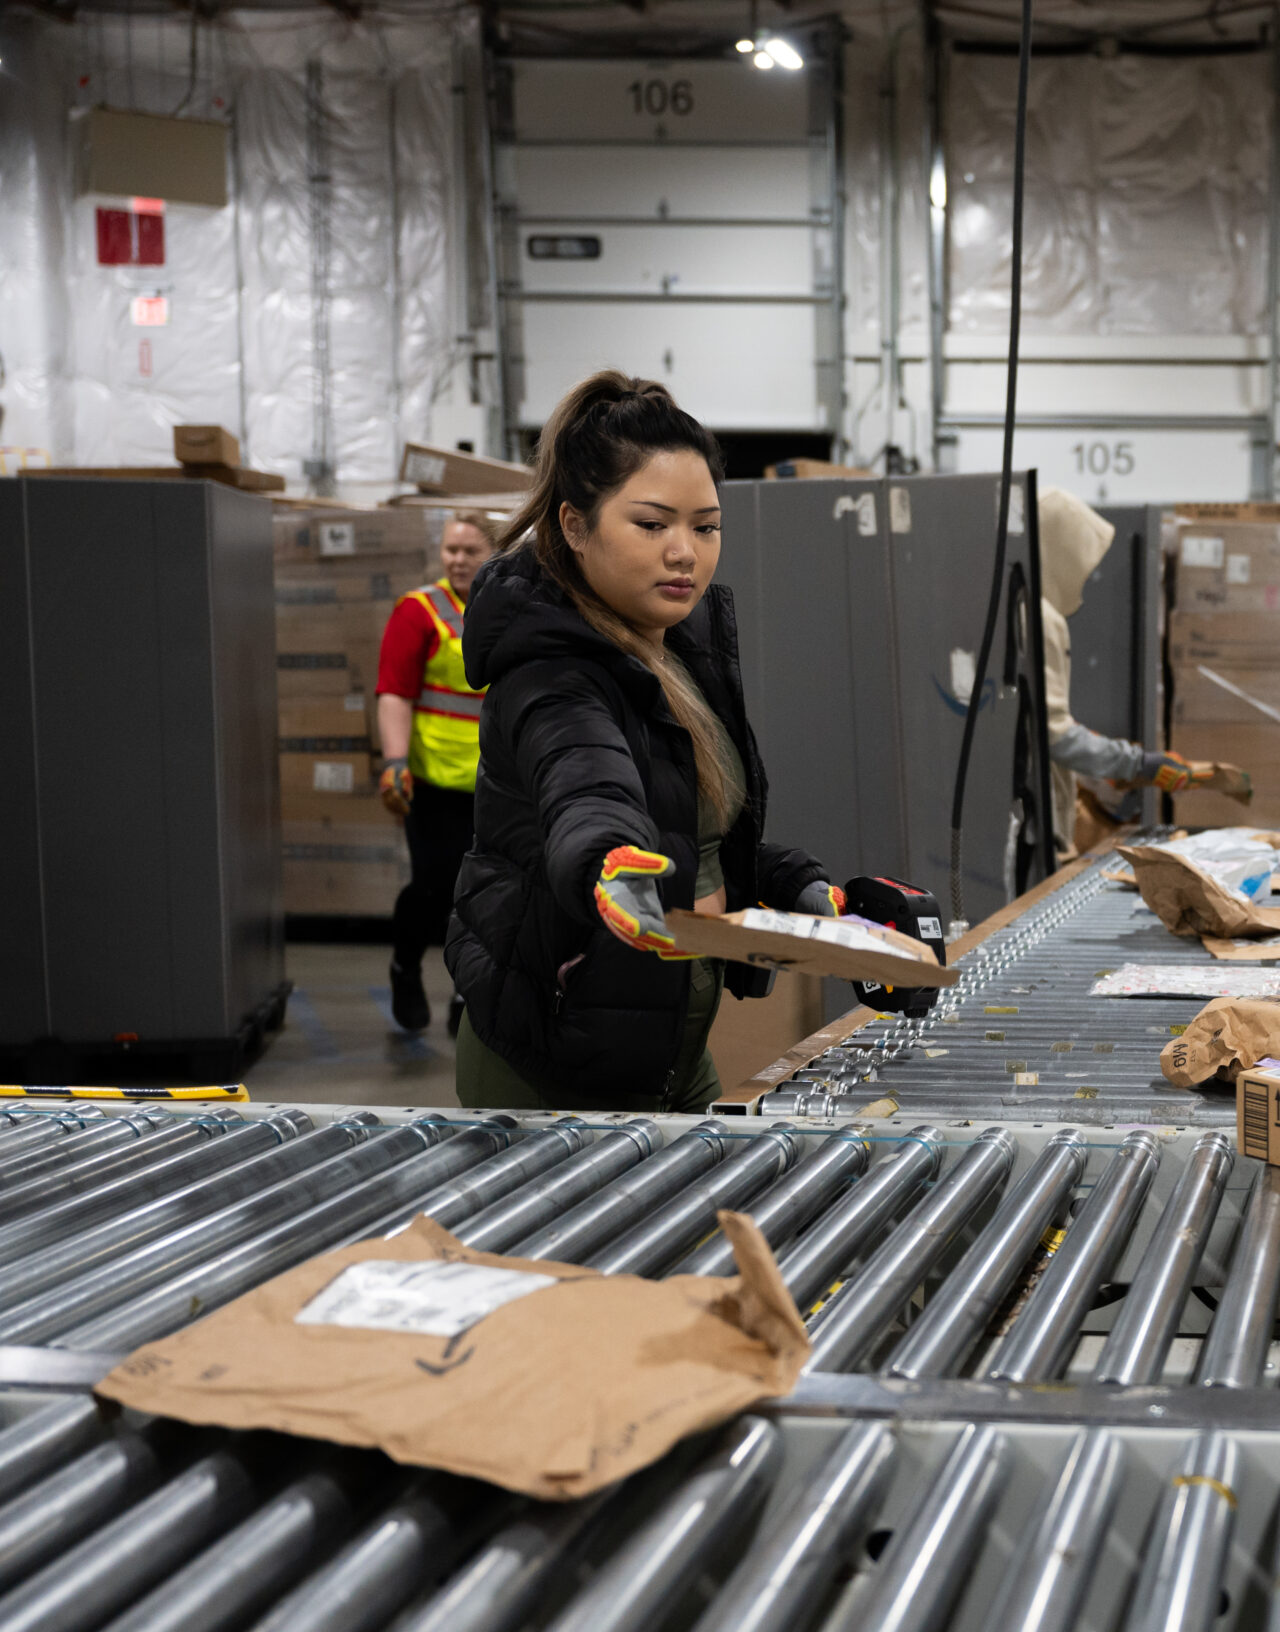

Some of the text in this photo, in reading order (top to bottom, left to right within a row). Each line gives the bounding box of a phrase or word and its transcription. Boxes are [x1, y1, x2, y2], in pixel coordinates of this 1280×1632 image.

[629, 79, 694, 116] 106
[1073, 441, 1136, 475] 105
[1173, 1043, 1188, 1068] M9
